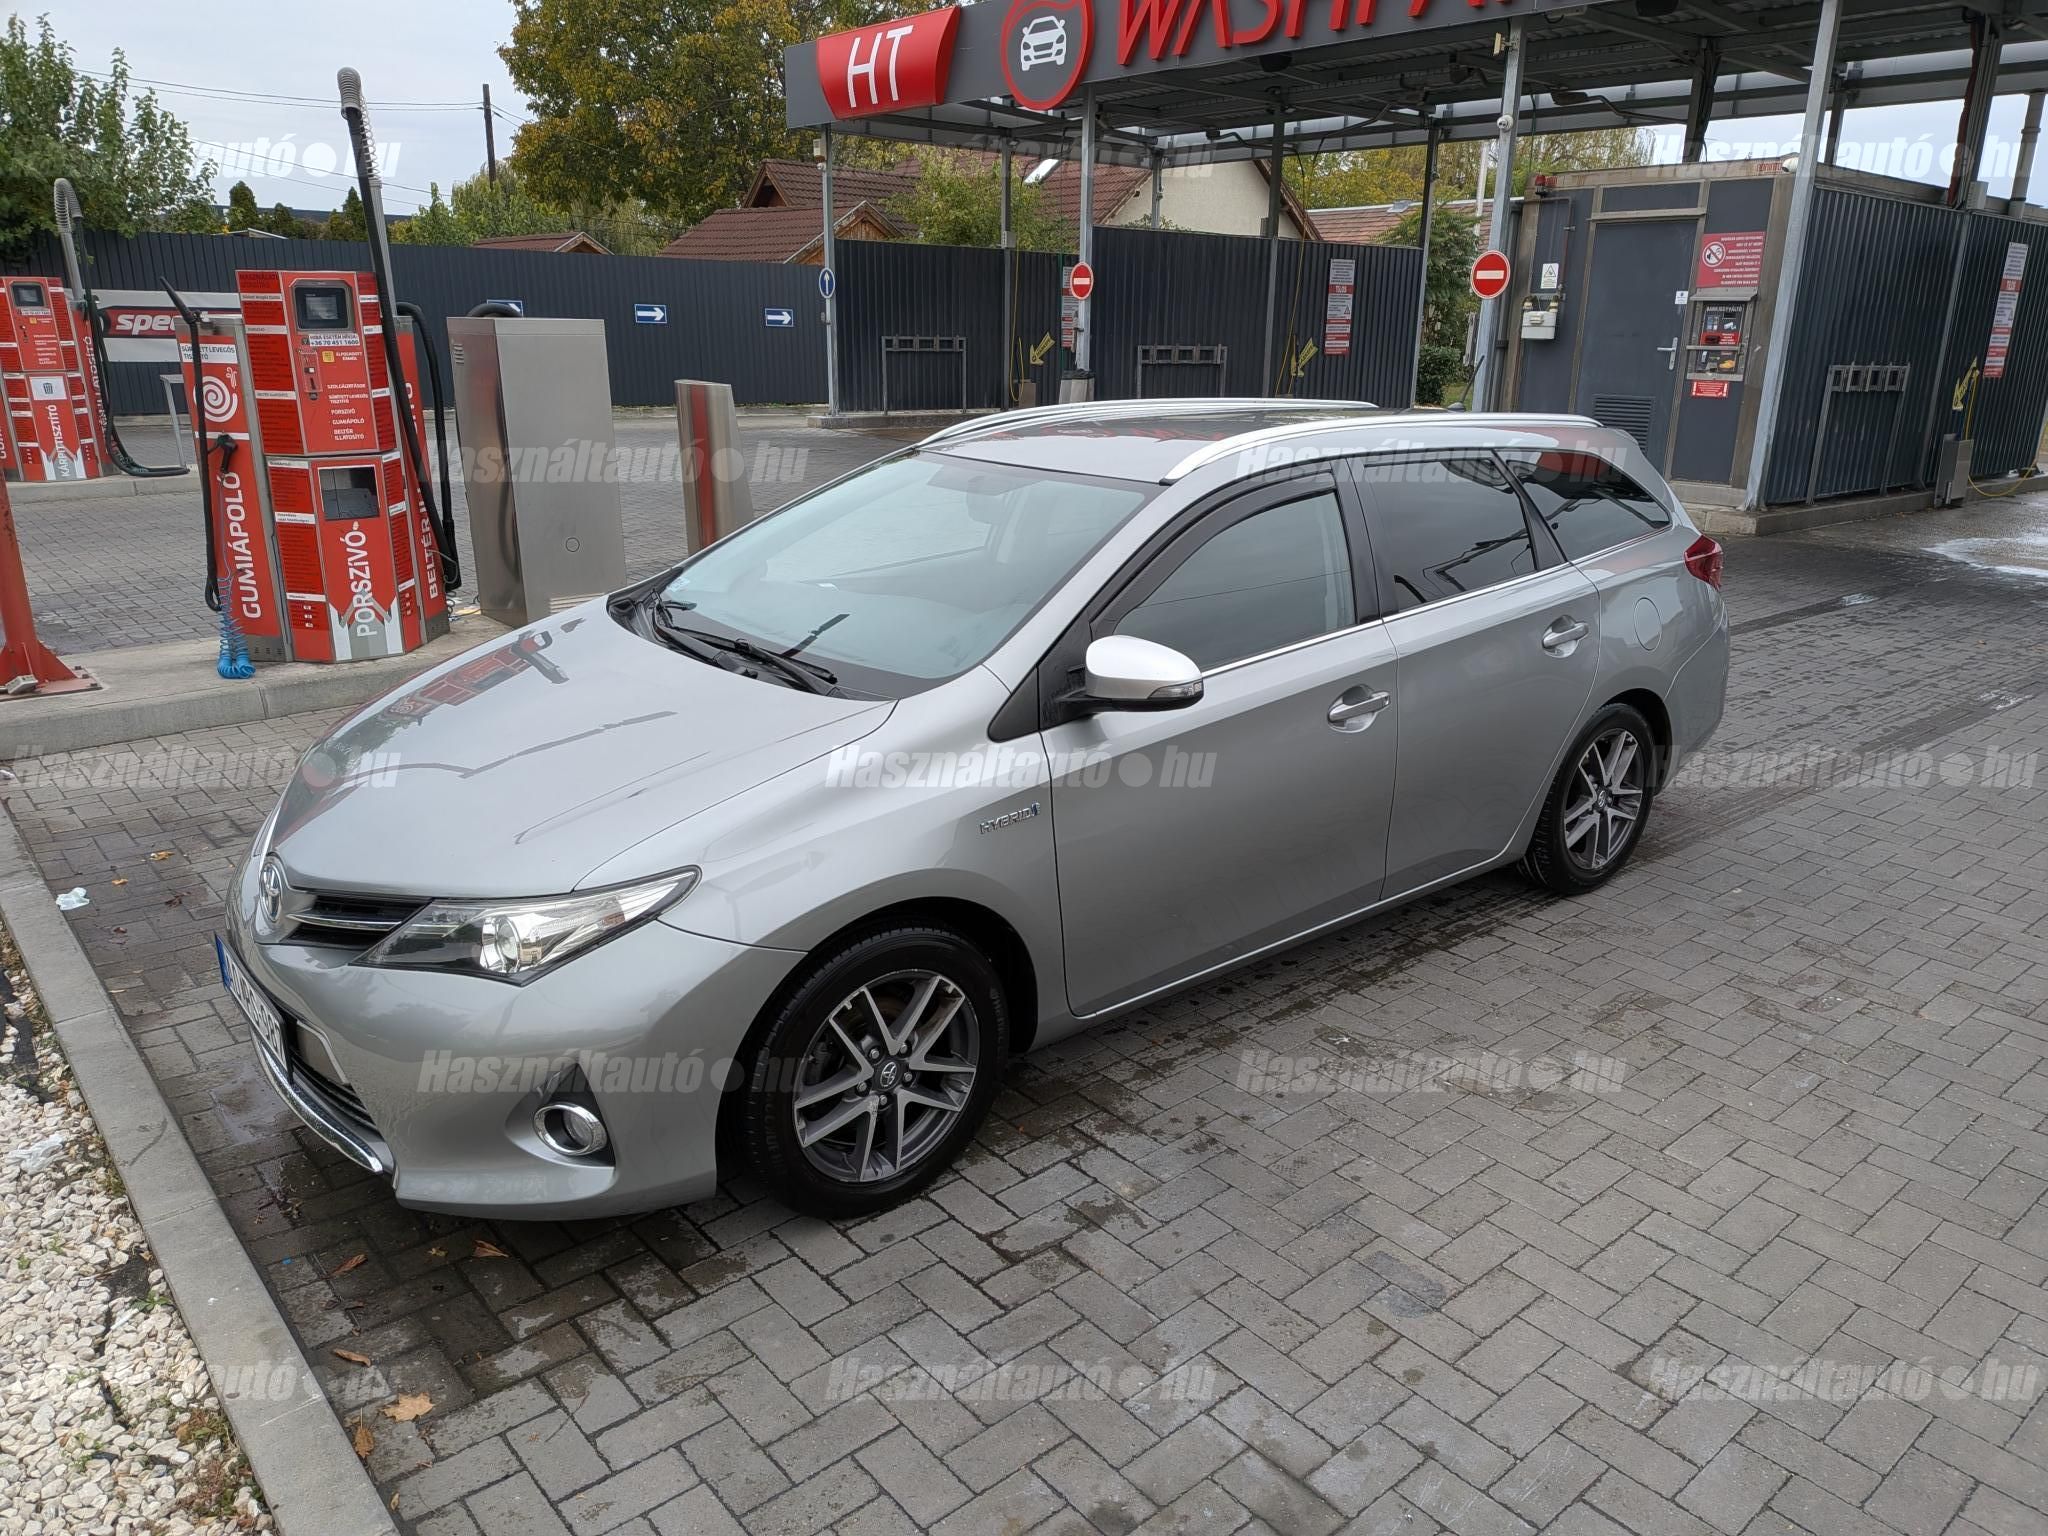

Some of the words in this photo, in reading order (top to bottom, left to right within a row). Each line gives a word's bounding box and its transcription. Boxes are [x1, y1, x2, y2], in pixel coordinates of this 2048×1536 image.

[847, 25, 914, 107] HT
[217, 471, 262, 619] GUMIÁPOLÓ
[340, 530, 378, 638] PORSZÍVÓ
